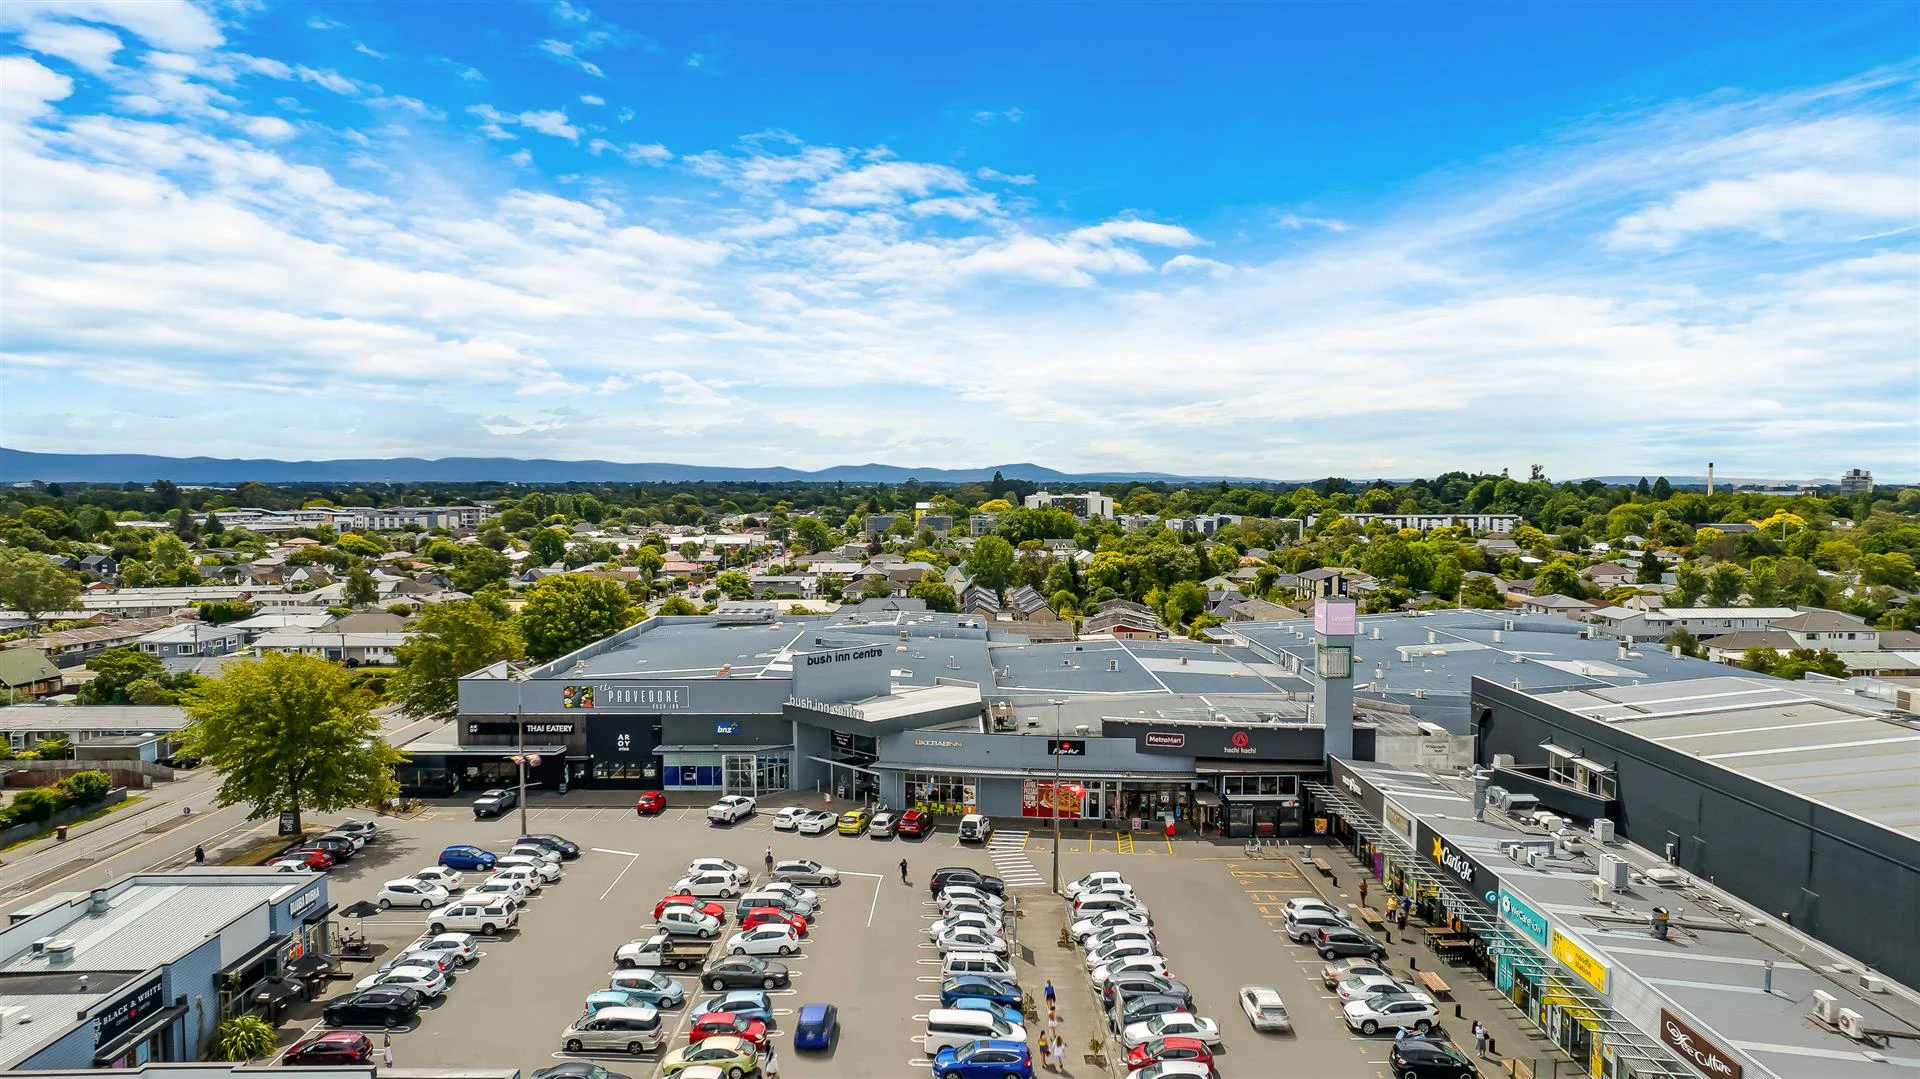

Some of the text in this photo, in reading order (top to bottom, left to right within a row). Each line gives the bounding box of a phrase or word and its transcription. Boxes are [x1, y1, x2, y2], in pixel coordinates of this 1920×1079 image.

[807, 648, 883, 666] bush inn centre
[608, 690, 679, 703] PROVEDORE
[789, 693, 865, 720] bush inn centre
[526, 724, 573, 732] THAI EATERY
[717, 725, 732, 733] bnz
[1149, 736, 1182, 744] MetroMart
[1441, 847, 1473, 882] Carl's Jr.
[103, 983, 162, 1025] BLACK & WHITE
[1694, 1051, 1733, 1077] Culture
